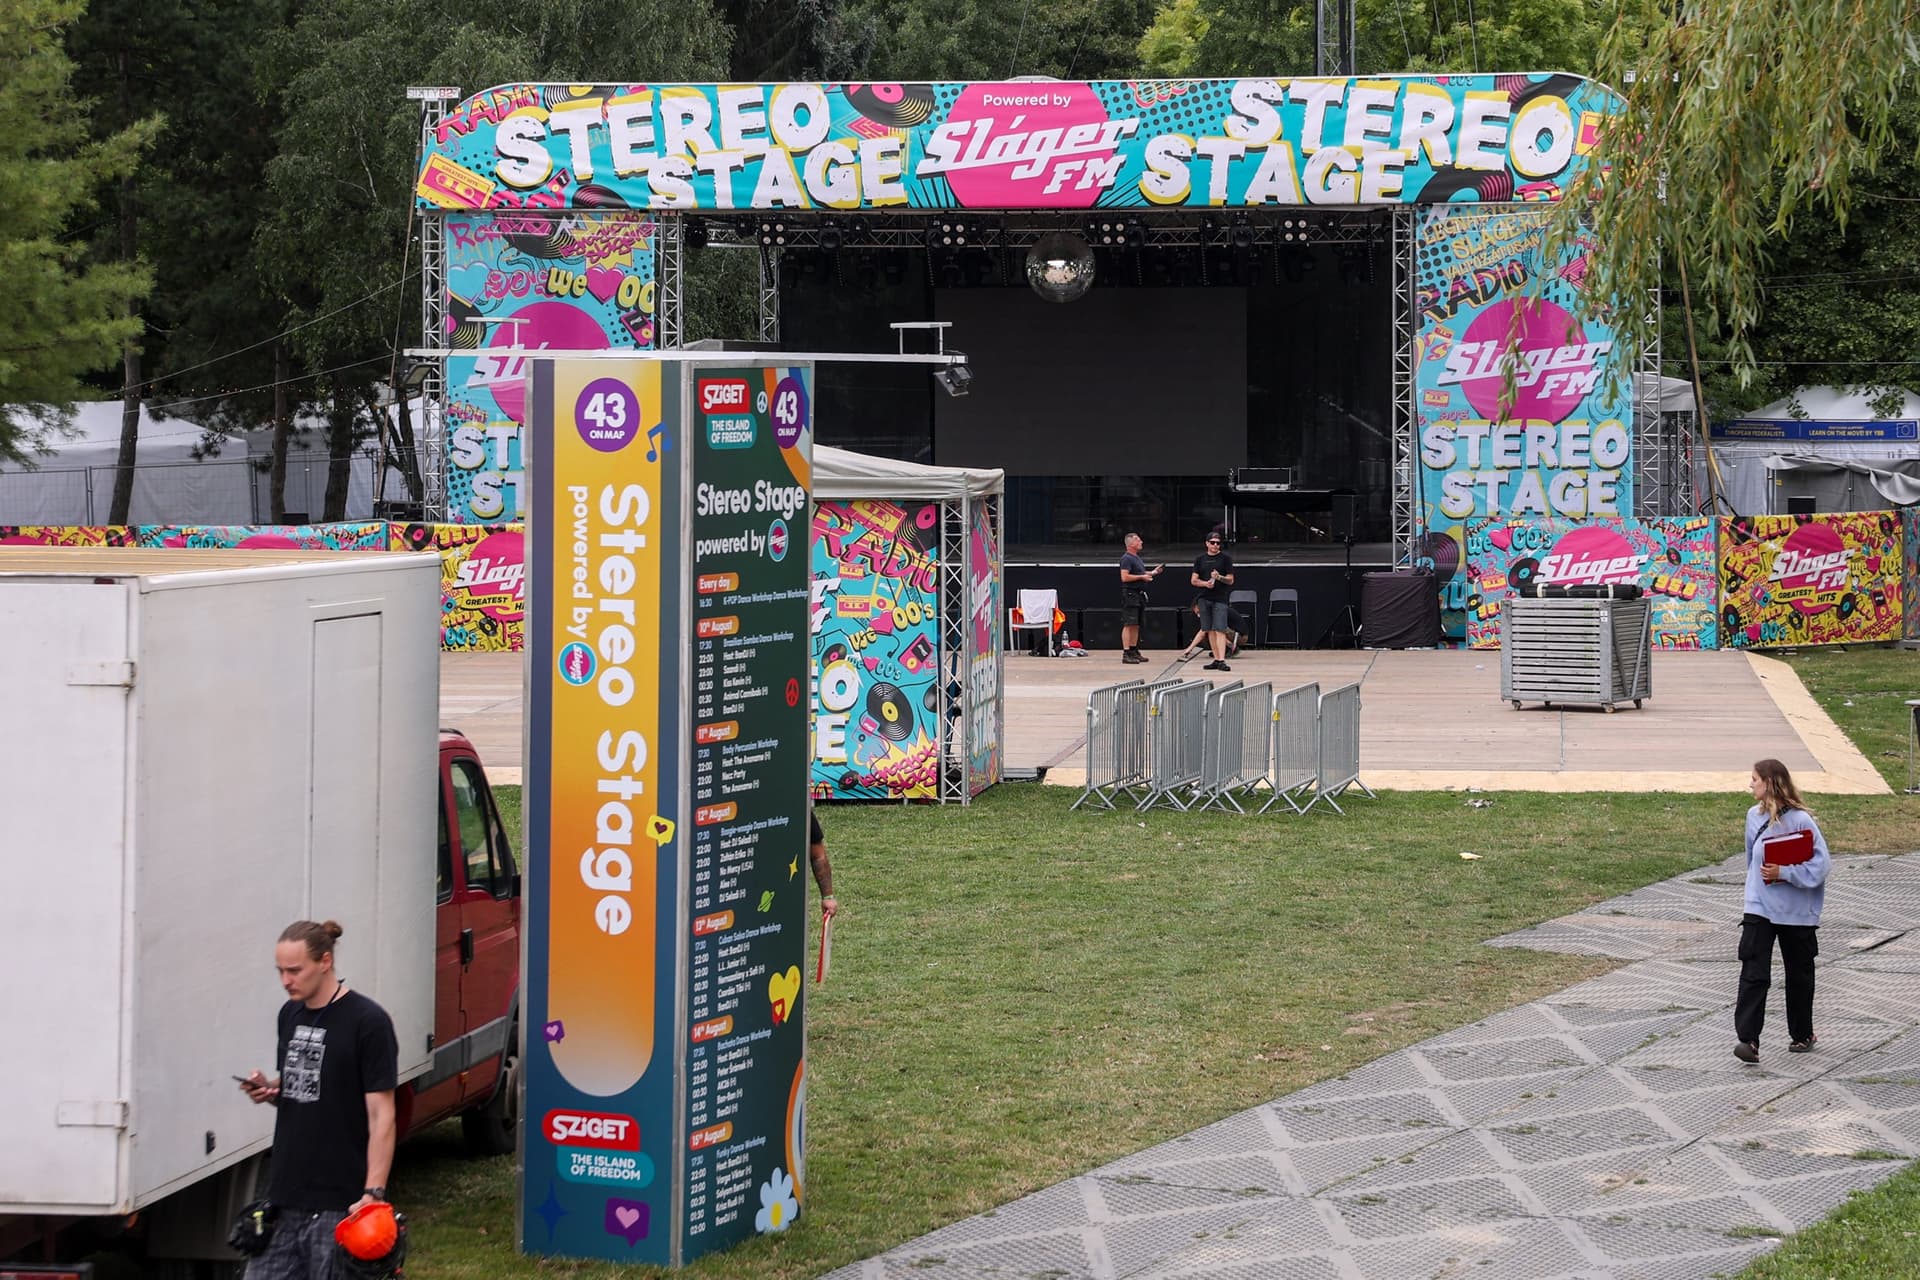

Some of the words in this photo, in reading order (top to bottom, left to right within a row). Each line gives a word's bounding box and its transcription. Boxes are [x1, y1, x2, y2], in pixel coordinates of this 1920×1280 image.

[984, 94, 1048, 106] Powered
[1053, 94, 1072, 108] by
[1225, 79, 1575, 179] STEREO
[495, 84, 831, 188] STEREO
[916, 115, 1140, 180] Sláger
[648, 137, 907, 208] STAGE
[1042, 155, 1127, 194] FM
[1140, 134, 1411, 205] STAGE
[1536, 369, 1604, 399] FM
[584, 392, 626, 428] 43
[776, 391, 798, 425] 43
[711, 420, 724, 431] THE
[725, 419, 750, 431] ISLAND
[589, 430, 604, 439] ON
[604, 430, 626, 439] MAP
[711, 432, 721, 443] OF
[722, 431, 752, 443] FREEDOM
[778, 428, 785, 437] ON
[785, 428, 796, 436] MAP
[1422, 420, 1630, 470] STEREO
[697, 482, 751, 516] Stereo
[754, 479, 805, 520] Stage
[1440, 470, 1623, 518] STAGE
[568, 486, 592, 599] powered
[696, 530, 748, 562] powered
[751, 529, 766, 557] by
[1533, 552, 1649, 583] Sláger
[1768, 548, 1856, 582] Sláger
[453, 556, 524, 591] Slág
[1818, 569, 1849, 590] FM
[700, 578, 717, 591] Every
[719, 576, 730, 590] day
[466, 596, 508, 606] GREATEST
[598, 484, 650, 706] Stereo
[752, 592, 772, 603] Workshop
[1778, 589, 1812, 600] GREATEST
[1816, 592, 1836, 602] HITS
[566, 607, 593, 638] by
[712, 620, 732, 635] August
[700, 641, 712, 650] 17:30
[773, 631, 794, 642] Workshop
[699, 654, 714, 663] 22:00
[698, 667, 713, 677] 23:00
[698, 681, 713, 691] 00:30
[698, 694, 712, 704] 01:30
[698, 708, 713, 718] 02:00
[709, 725, 730, 740] August
[758, 738, 778, 749] Workshop
[698, 762, 712, 772] 22:00
[697, 775, 712, 786] 23:00
[709, 806, 730, 821] August
[580, 729, 648, 936] Stage
[697, 831, 710, 841] 17:30
[768, 816, 789, 827] Workshop
[696, 844, 711, 855] 22:00
[696, 858, 711, 869] 23:00
[696, 871, 711, 882] 00:30
[696, 885, 709, 896] 01:30
[695, 898, 711, 909] 02:00
[707, 915, 728, 930] August
[760, 923, 781, 935] Workshop
[695, 953, 709, 965] 22:00
[694, 967, 709, 978] 23:00
[694, 980, 709, 992] 00:30
[694, 994, 707, 1005] 01:30
[694, 1008, 709, 1019] 02:00
[706, 1021, 726, 1036] August
[750, 1029, 772, 1041] Workshop
[693, 1060, 708, 1072] 22:00
[692, 1073, 707, 1085] 23:00
[692, 1087, 707, 1099] 00:30
[692, 1101, 706, 1112] 01:30
[692, 1114, 707, 1126] 02:00
[704, 1127, 726, 1144] August
[745, 1135, 766, 1149] Workshop
[571, 1154, 592, 1165] THE
[594, 1155, 636, 1169] ISLAND
[570, 1164, 586, 1176] OF
[588, 1166, 640, 1180] FREEDOM
[691, 1168, 706, 1180] 22:00
[690, 1182, 706, 1194] 23:00
[690, 1195, 706, 1208] 00:30
[690, 1209, 704, 1222] 01:30
[690, 1222, 706, 1235] 02:00
